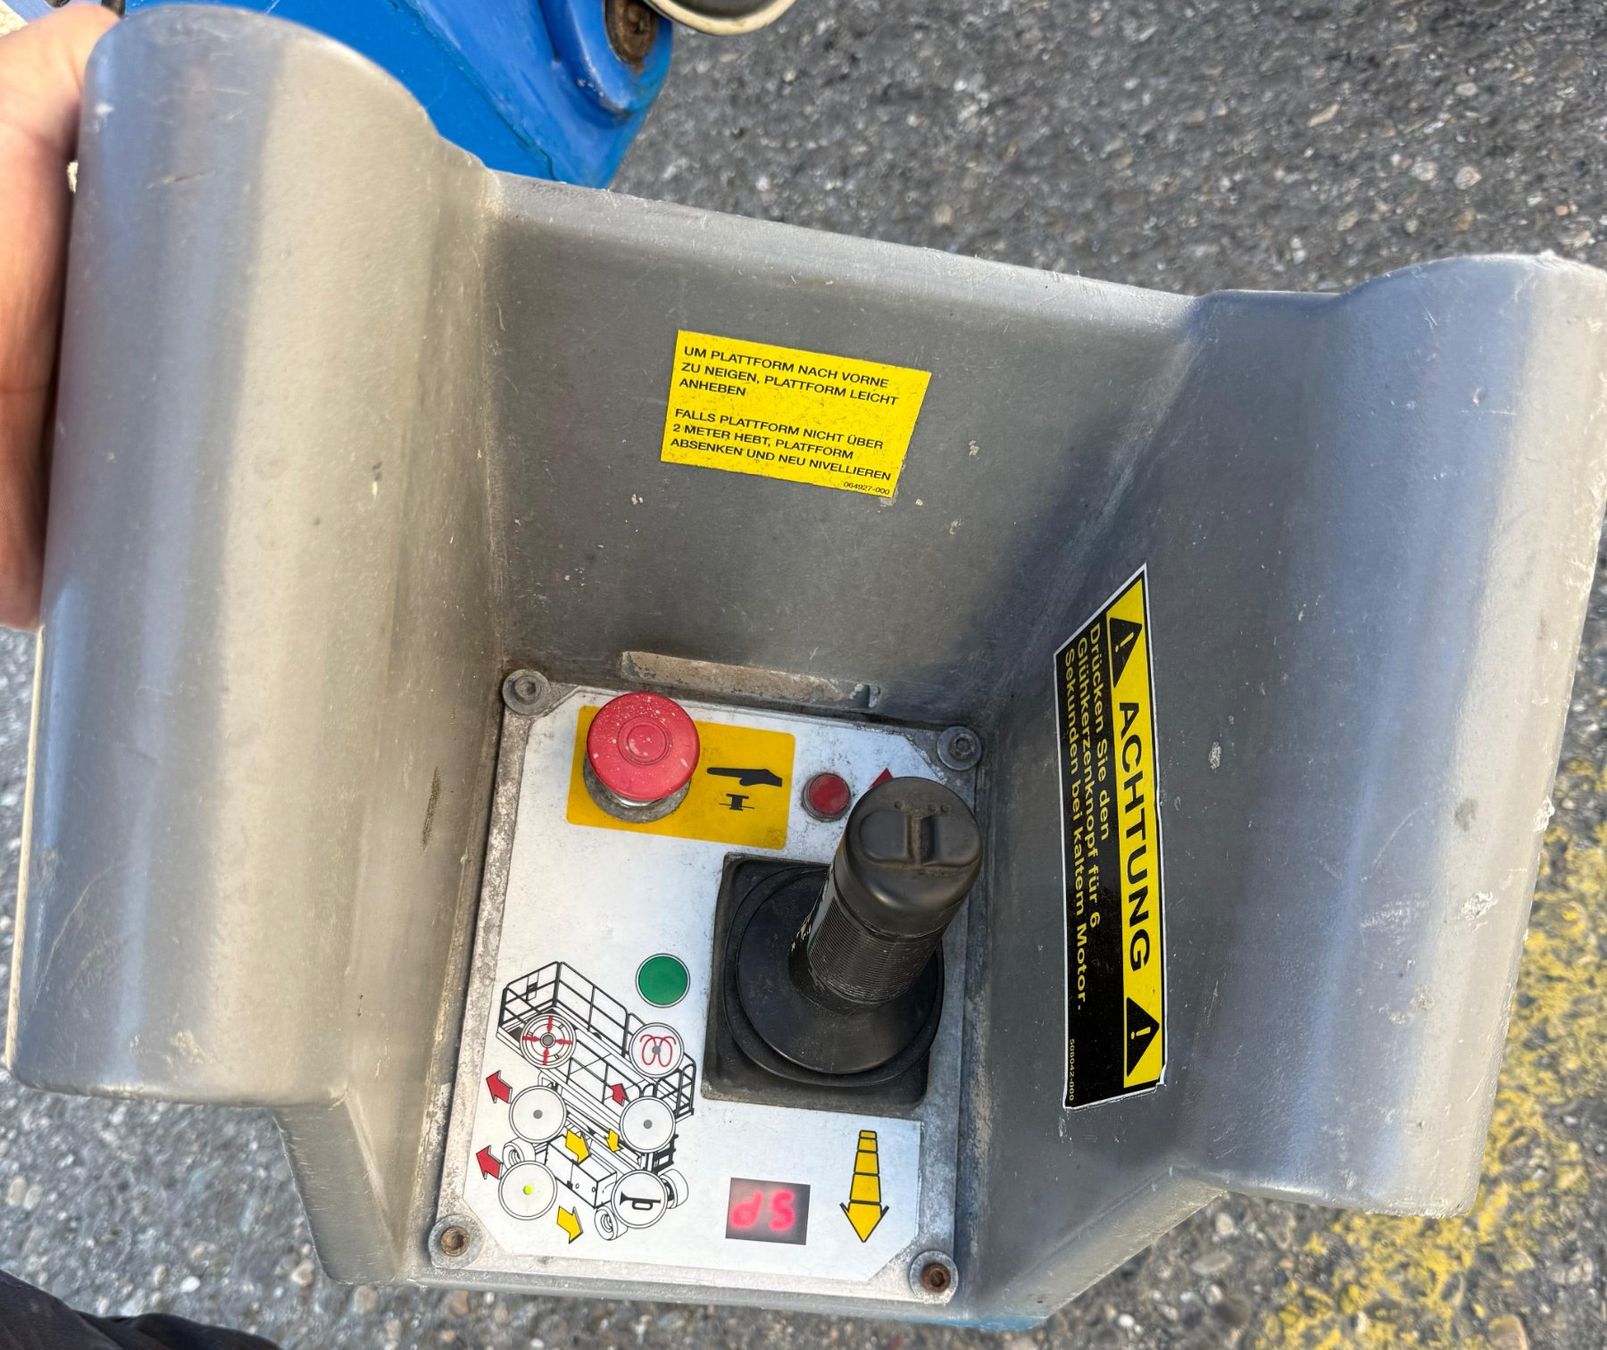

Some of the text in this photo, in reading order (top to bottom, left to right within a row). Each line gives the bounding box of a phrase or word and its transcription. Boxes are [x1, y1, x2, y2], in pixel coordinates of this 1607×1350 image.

[679, 378, 746, 396] ANHEBEN
[681, 362, 899, 406] ZU NEIGEN, PLATTFORM LEICHT
[684, 346, 889, 388] UM PLATTFORM NACH VORNE
[672, 423, 681, 432] 2
[684, 424, 731, 439] METER
[734, 432, 771, 447] HEBT,
[675, 408, 884, 449] FALLS PLATTFORM NICHT ÜBER
[670, 438, 891, 480] ABSENKEN UND NEU NIVELLIEREN
[1065, 648, 1079, 775] Sekunden
[1089, 622, 1110, 841] Drücken Sie den
[1071, 779, 1083, 821] bei
[1077, 637, 1101, 928] Glühkerzenknopf für 6
[1119, 702, 1151, 972] ACHTUNG
[1073, 826, 1085, 916] kaltem
